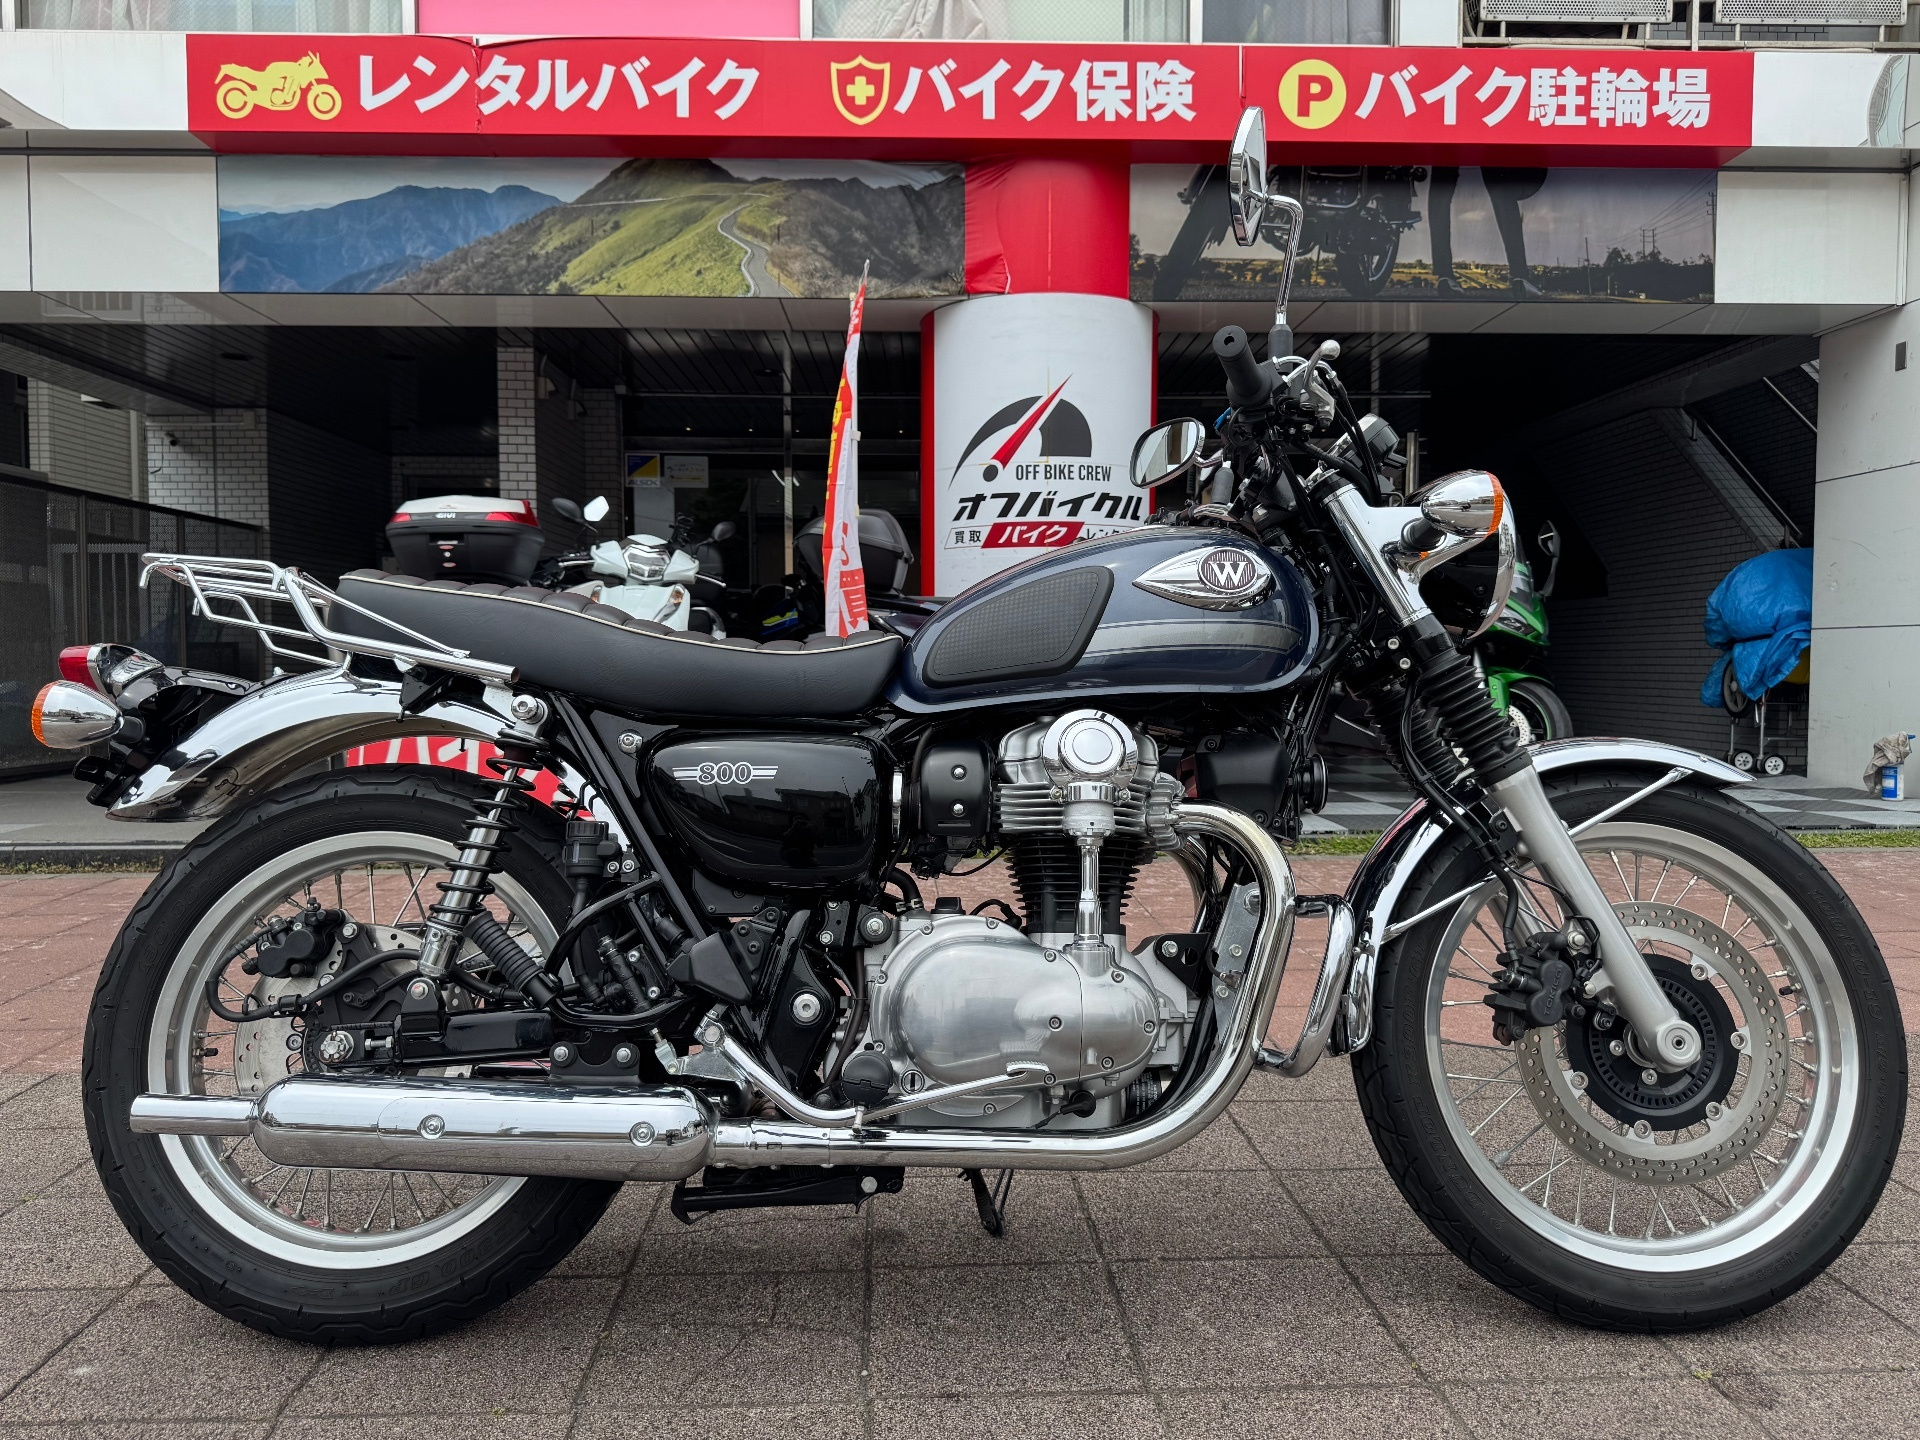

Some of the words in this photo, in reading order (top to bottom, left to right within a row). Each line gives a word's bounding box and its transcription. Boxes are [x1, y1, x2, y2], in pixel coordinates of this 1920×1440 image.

[359, 55, 760, 120] レンタルバイク
[894, 58, 1197, 122] バイク保険
[1355, 64, 1711, 128] バイク駐輪場
[1016, 464, 1039, 481] OFF
[1044, 464, 1074, 480] BIKE
[1078, 465, 1112, 482] CREW
[952, 491, 1142, 521] オフバイクル
[954, 530, 982, 545] 買取
[998, 525, 1068, 544] バイク
[1208, 561, 1249, 587] W
[696, 761, 753, 785] 800
[1543, 968, 1562, 1015] TOKICO
